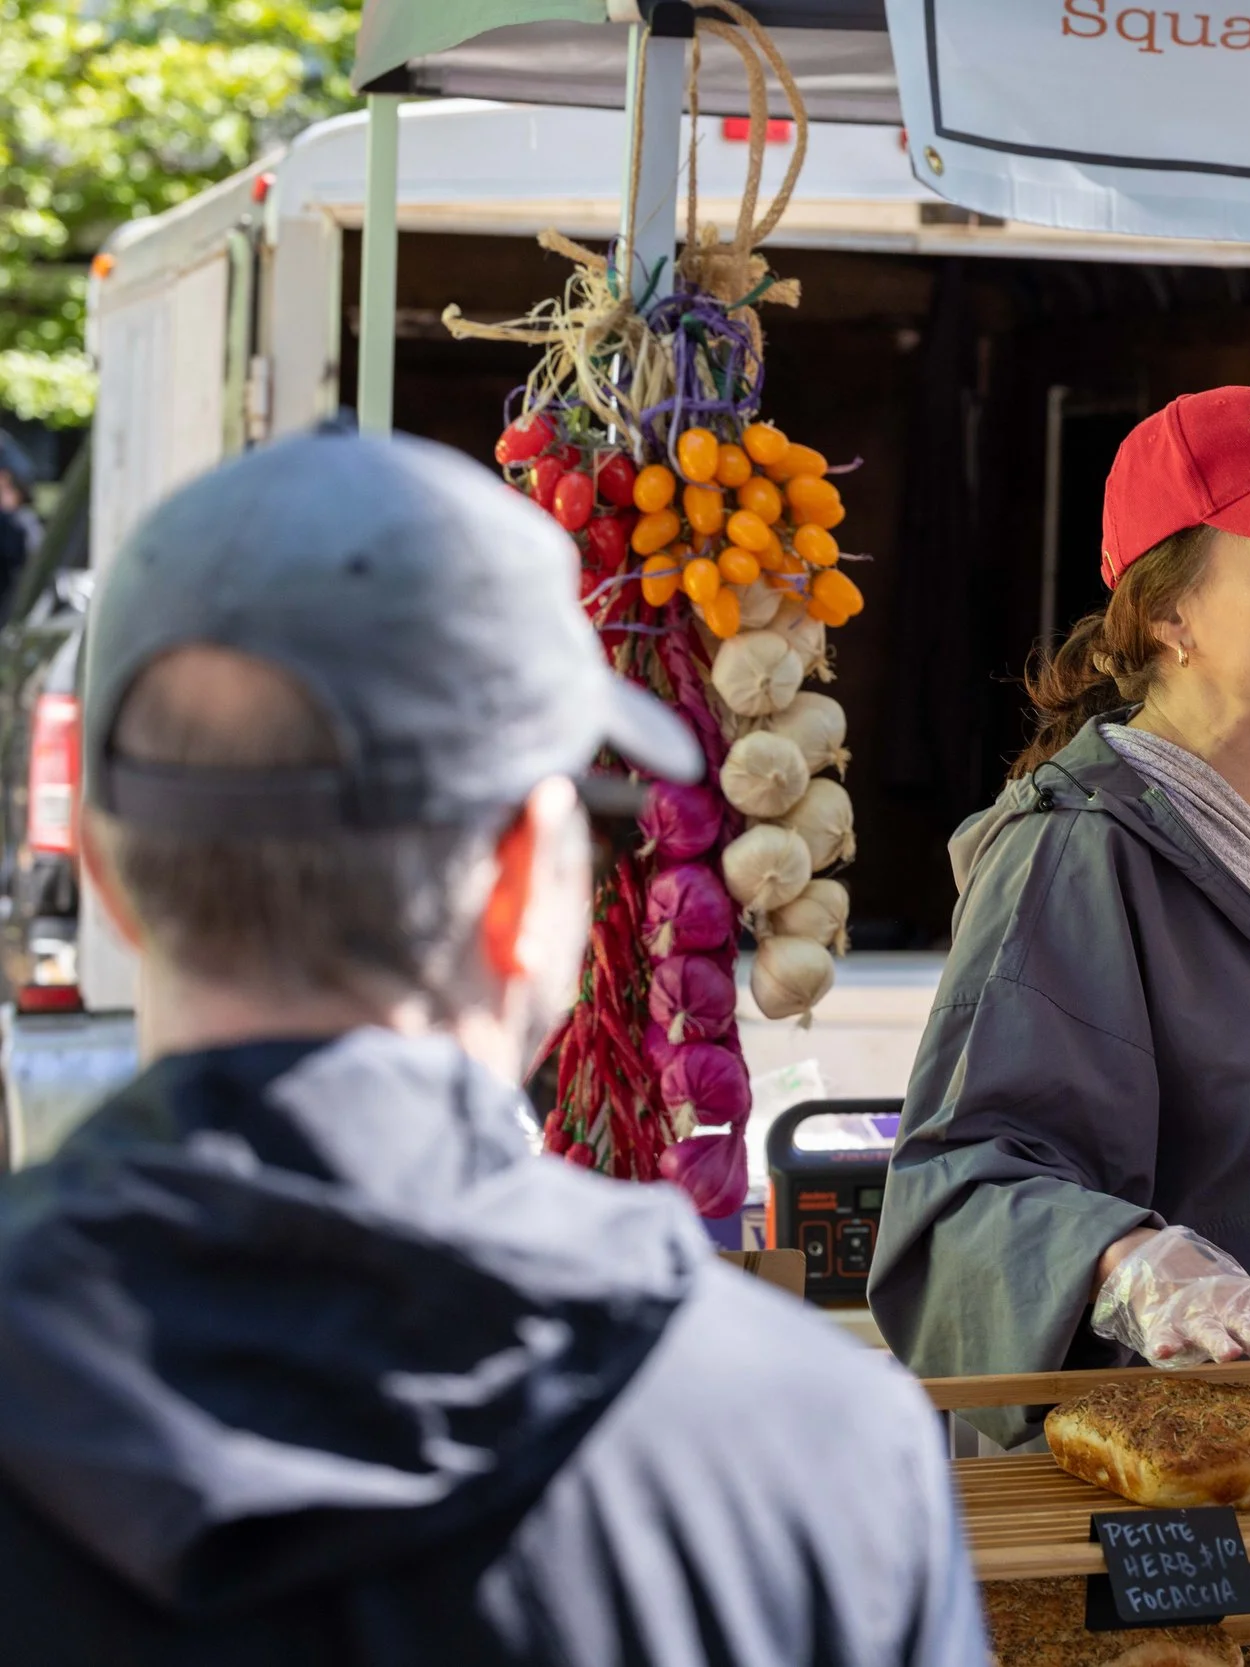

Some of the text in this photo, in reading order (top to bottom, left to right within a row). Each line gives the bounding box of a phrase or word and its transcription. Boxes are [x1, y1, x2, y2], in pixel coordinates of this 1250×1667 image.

[1103, 1522, 1196, 1548] PETITE
[1123, 1551, 1198, 1578] HERB
[1126, 1576, 1238, 1613] FOCACCIA
